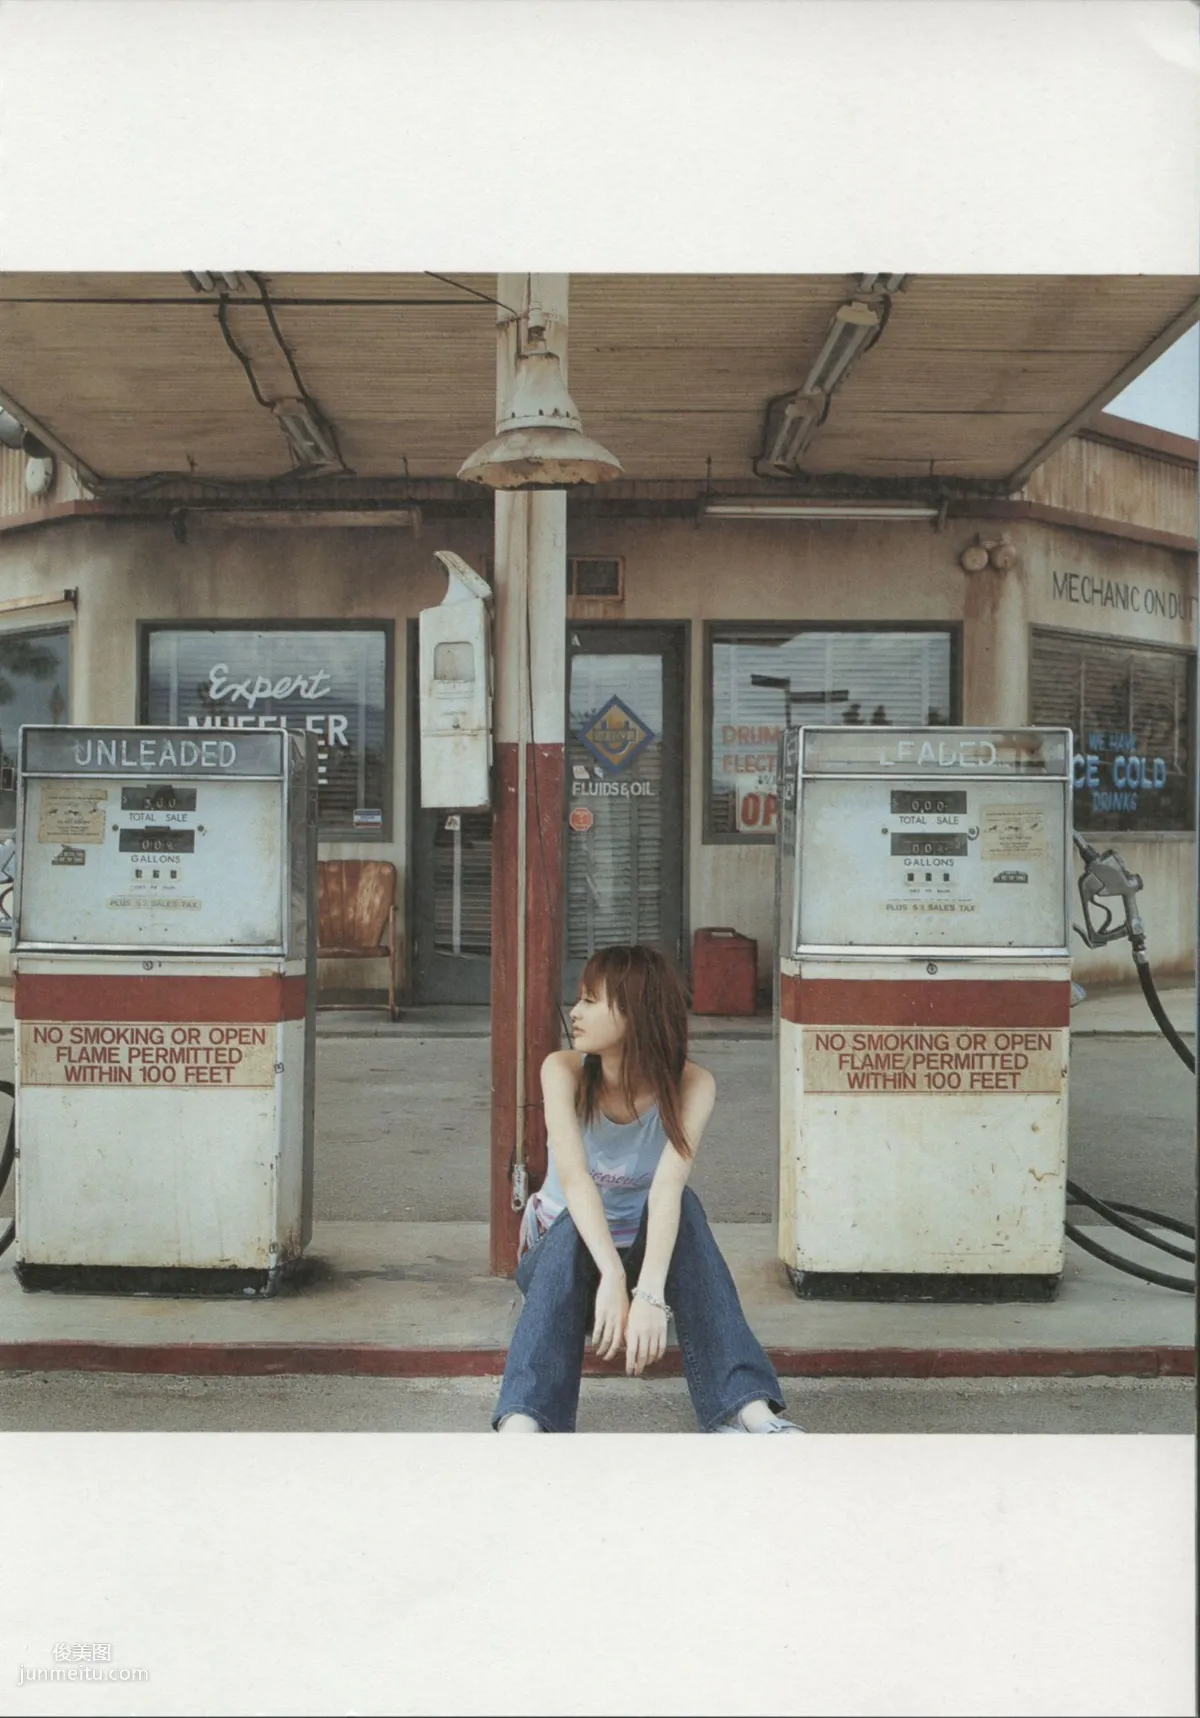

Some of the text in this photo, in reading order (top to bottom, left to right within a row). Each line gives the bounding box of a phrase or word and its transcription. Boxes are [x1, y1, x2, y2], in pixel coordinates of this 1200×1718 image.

[1053, 570, 1140, 612] MECHANIC
[1144, 589, 1166, 617] ON
[209, 663, 331, 709] Expert
[75, 739, 236, 768] UNLEADED
[1113, 755, 1167, 789] COLD
[1092, 791, 1138, 813] DRINKS
[129, 812, 188, 823] TOTAL SALE
[899, 815, 959, 825] TOTAL SALE
[131, 854, 180, 864] GALLONS
[904, 858, 954, 867] GALLONS
[886, 903, 908, 911] PLUS
[928, 903, 955, 911] SALES
[959, 904, 976, 912] TAX
[33, 1026, 266, 1045] NO SMOKING OR OPEN
[815, 1033, 1052, 1051] NO SMOKING OR OPEN
[56, 1047, 243, 1064] FLAME PERMITTED
[838, 1053, 1029, 1070] FLAME PERMITTED
[64, 1065, 235, 1083] WITHIN 100 FEET
[847, 1072, 1021, 1089] WITHIN 100 FEET
